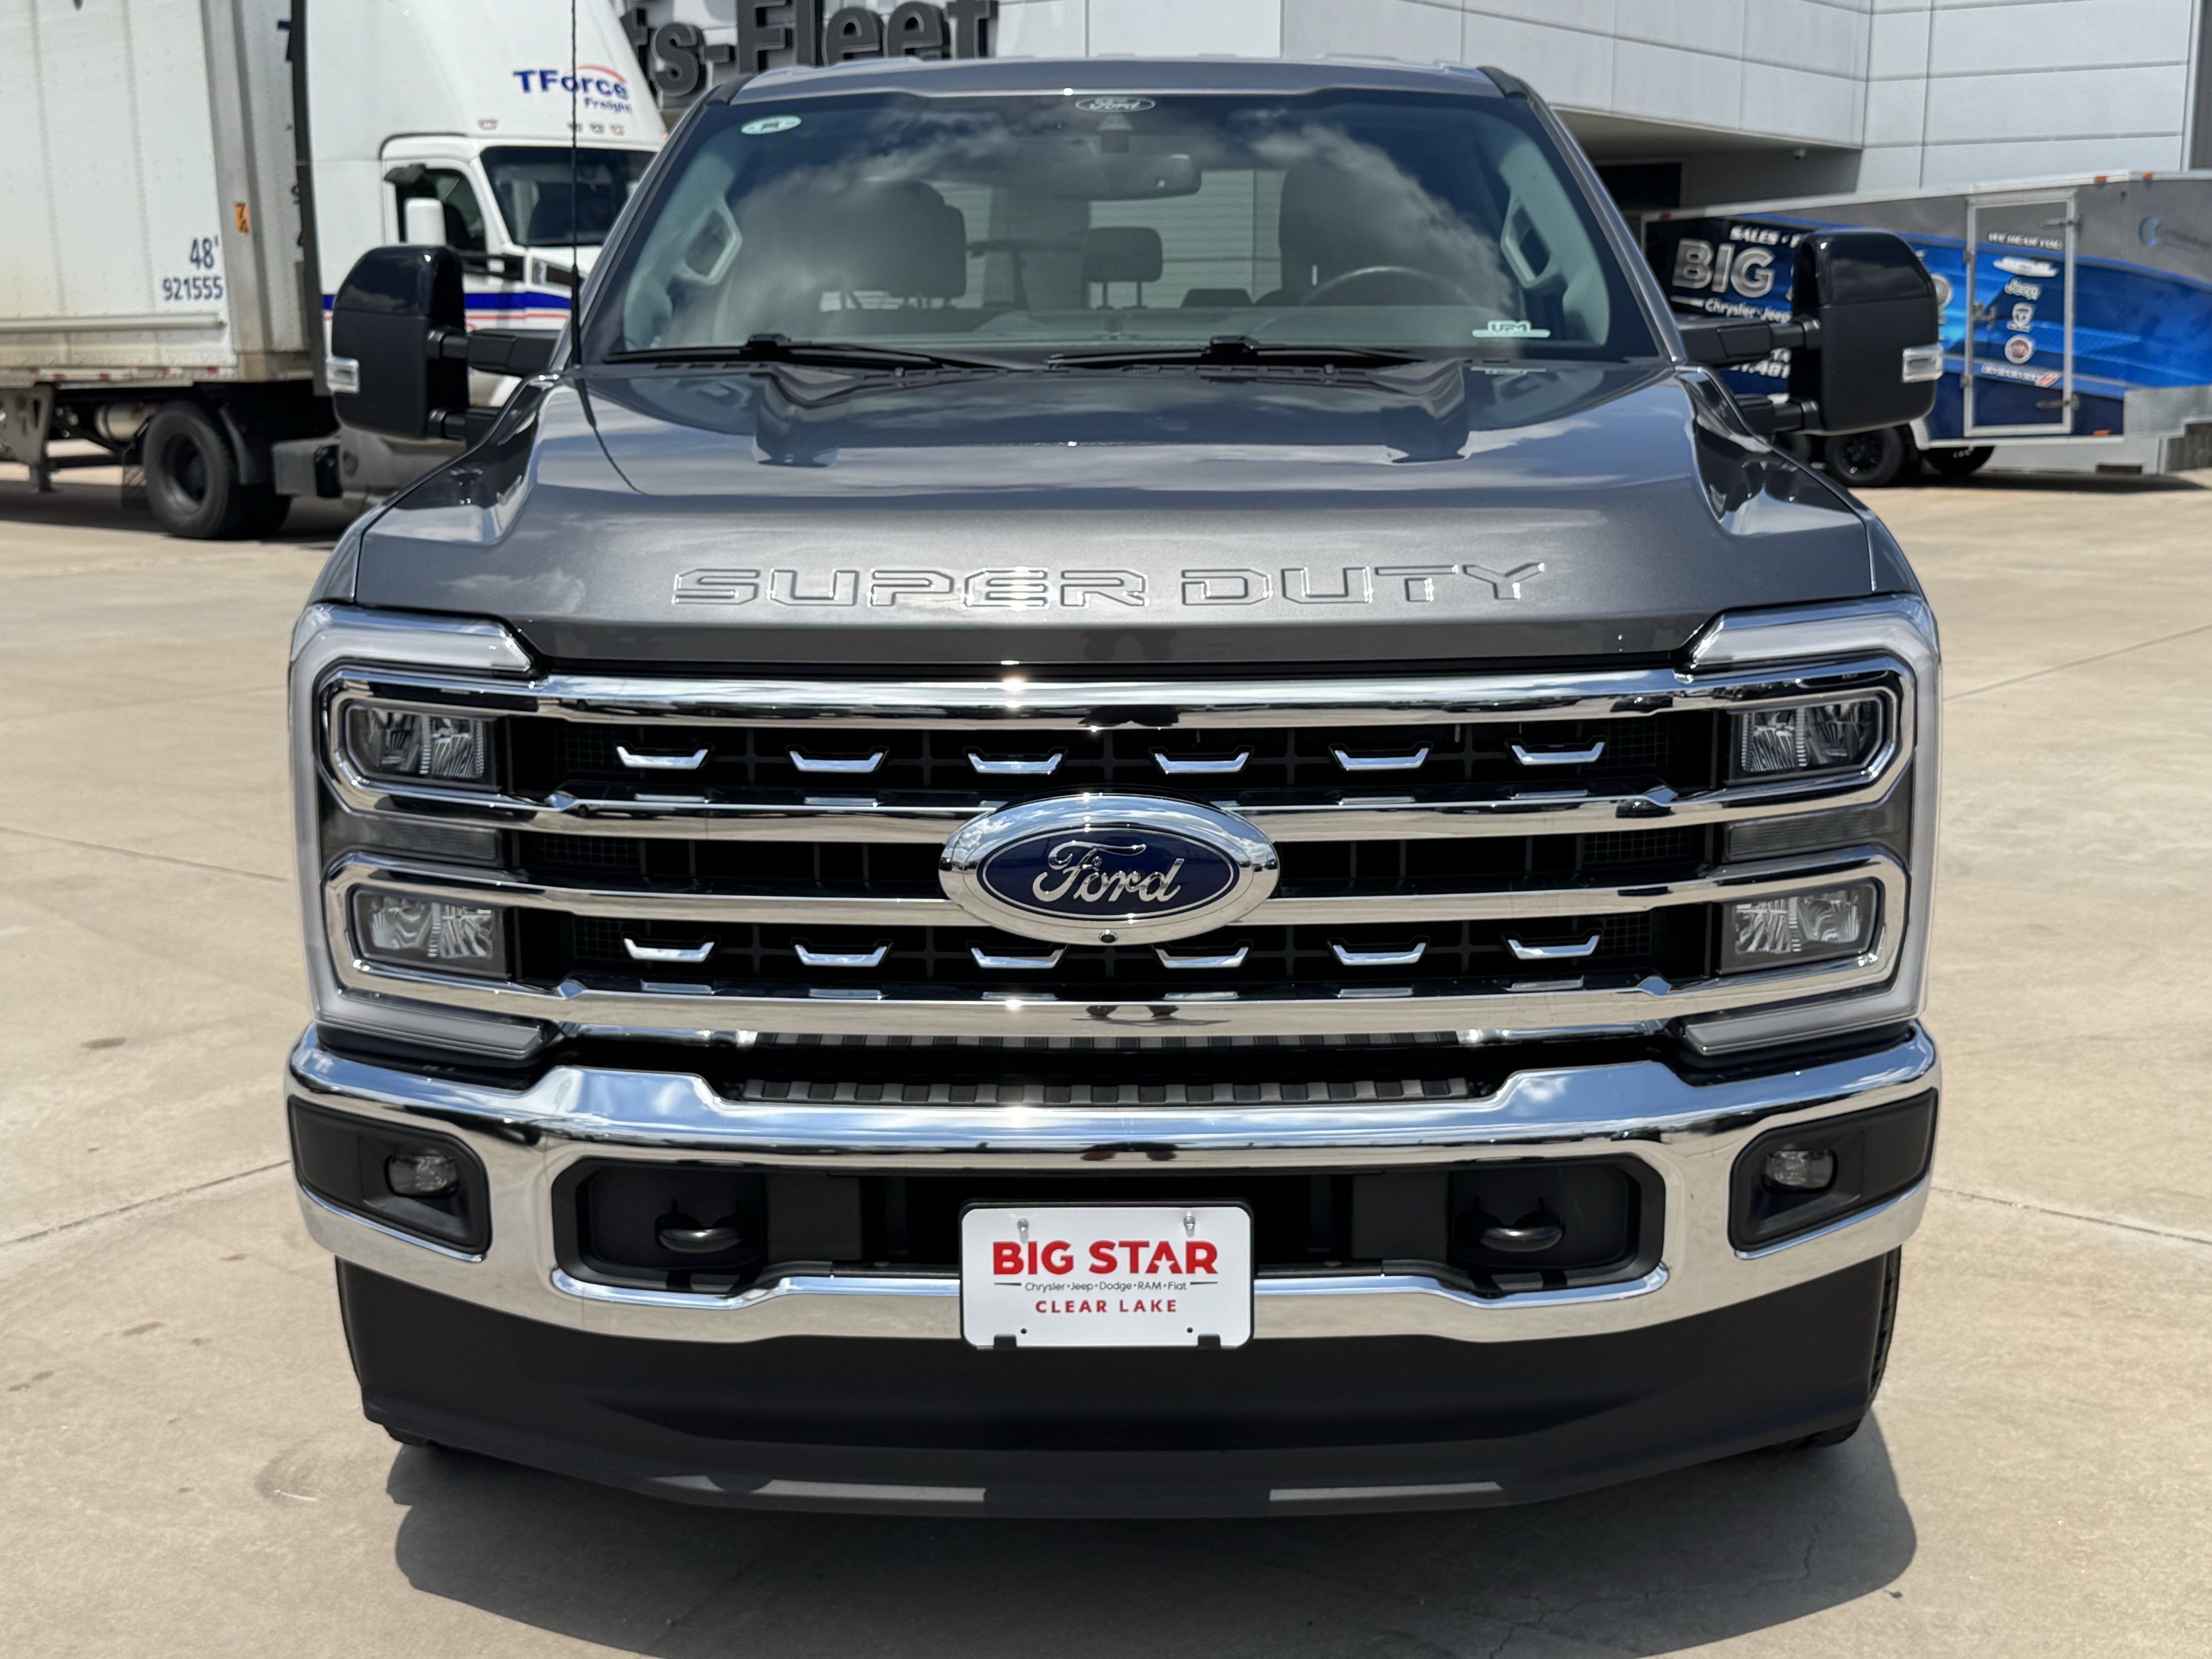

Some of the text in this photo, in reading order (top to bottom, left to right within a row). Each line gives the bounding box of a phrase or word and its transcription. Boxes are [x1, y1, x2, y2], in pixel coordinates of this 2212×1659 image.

[513, 69, 629, 100] TForce
[1089, 97, 1141, 110] Ford
[1729, 225, 1781, 245] SALES
[189, 235, 220, 271] 48'
[1671, 238, 1776, 298] BIG
[161, 275, 224, 302] 921555
[1705, 297, 1756, 318] Chrysler
[672, 562, 1545, 607] SUPER DUTY
[1032, 840, 1185, 903] Ford
[993, 1239, 1218, 1275] BIG STAR
[1035, 1299, 1177, 1313] CLEAR LAKE
